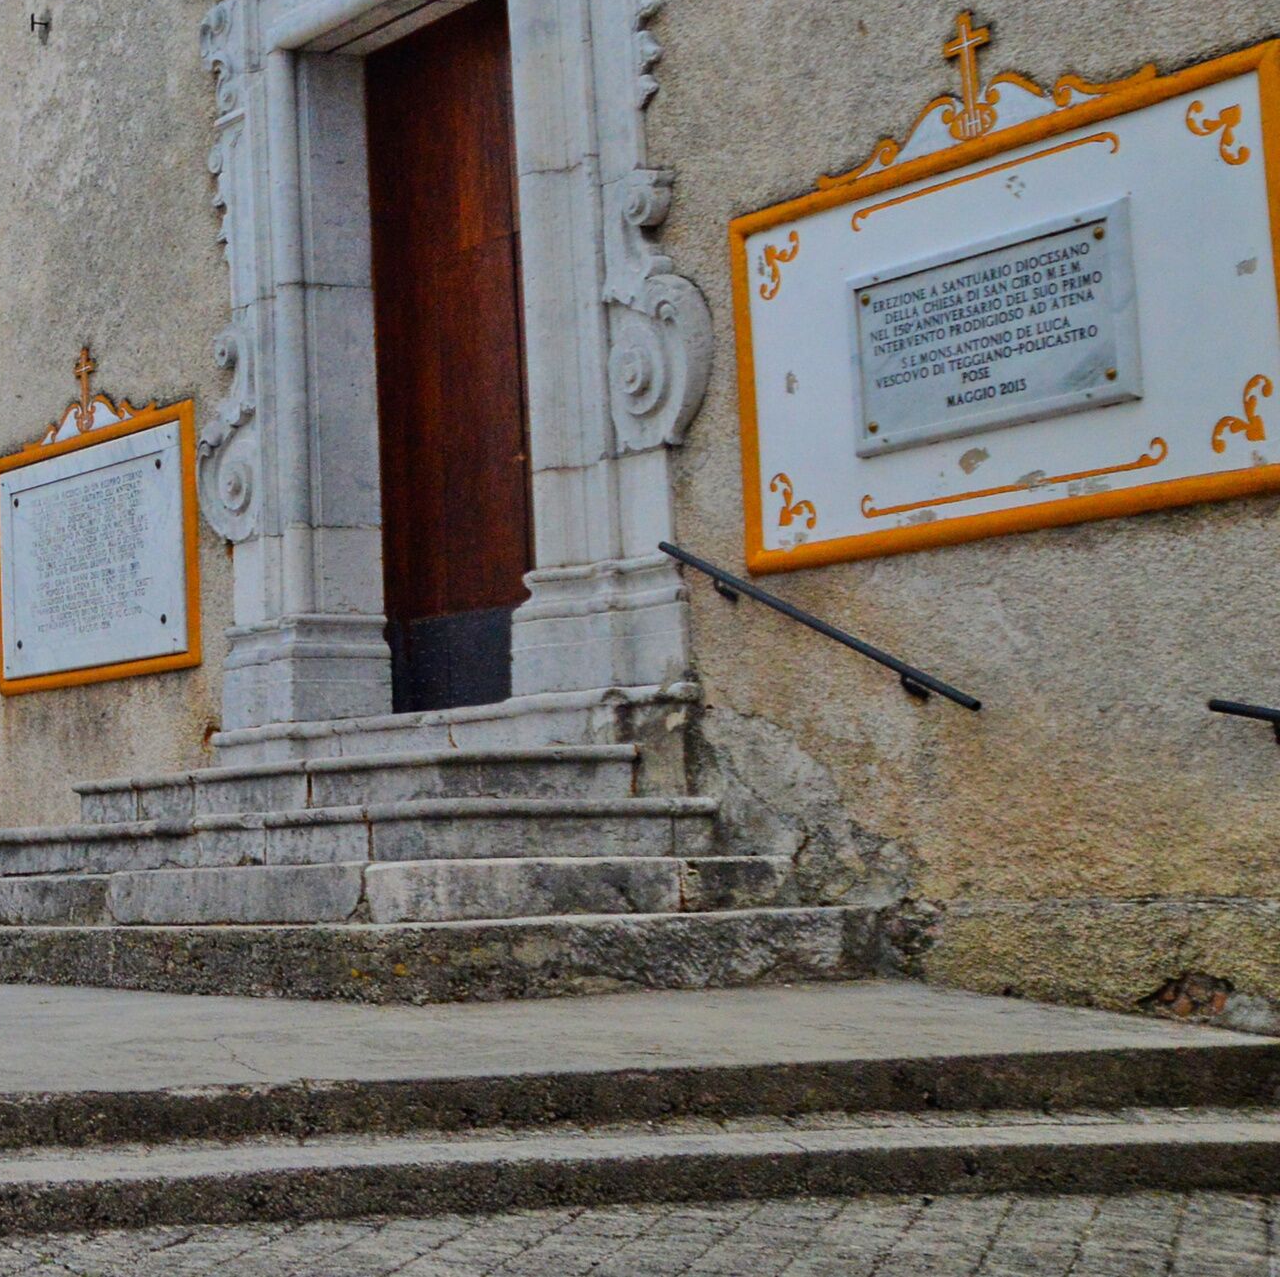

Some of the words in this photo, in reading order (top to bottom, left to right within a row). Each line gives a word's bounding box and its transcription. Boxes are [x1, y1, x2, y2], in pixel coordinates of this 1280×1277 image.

[872, 288, 927, 314] EREZIONE
[930, 285, 938, 298] A
[942, 264, 1012, 294] SANTUARIO
[1015, 242, 1090, 273] DIOCESANO
[885, 306, 919, 325] DELLA
[923, 294, 963, 314] CHIESA
[967, 288, 980, 302] DI
[983, 282, 1008, 298] SAN
[1011, 272, 1042, 289] CIRO
[870, 328, 889, 342] NEL
[1006, 291, 1028, 306] DEL
[1033, 283, 1058, 300] SUO
[1062, 270, 1103, 292] PRIMO
[873, 328, 946, 356] INTERVENTO
[949, 307, 1024, 337] PRODIGIOSO
[1029, 301, 1047, 316] AD
[1051, 289, 1095, 311] ATENA
[1016, 325, 1033, 340] DE
[1036, 316, 1071, 335] LUCA
[875, 367, 929, 388] VESCOVO
[933, 362, 945, 376] DI
[947, 386, 996, 407] MAGGIO
[1000, 378, 1027, 395] 2013
[961, 366, 991, 384] POSE
